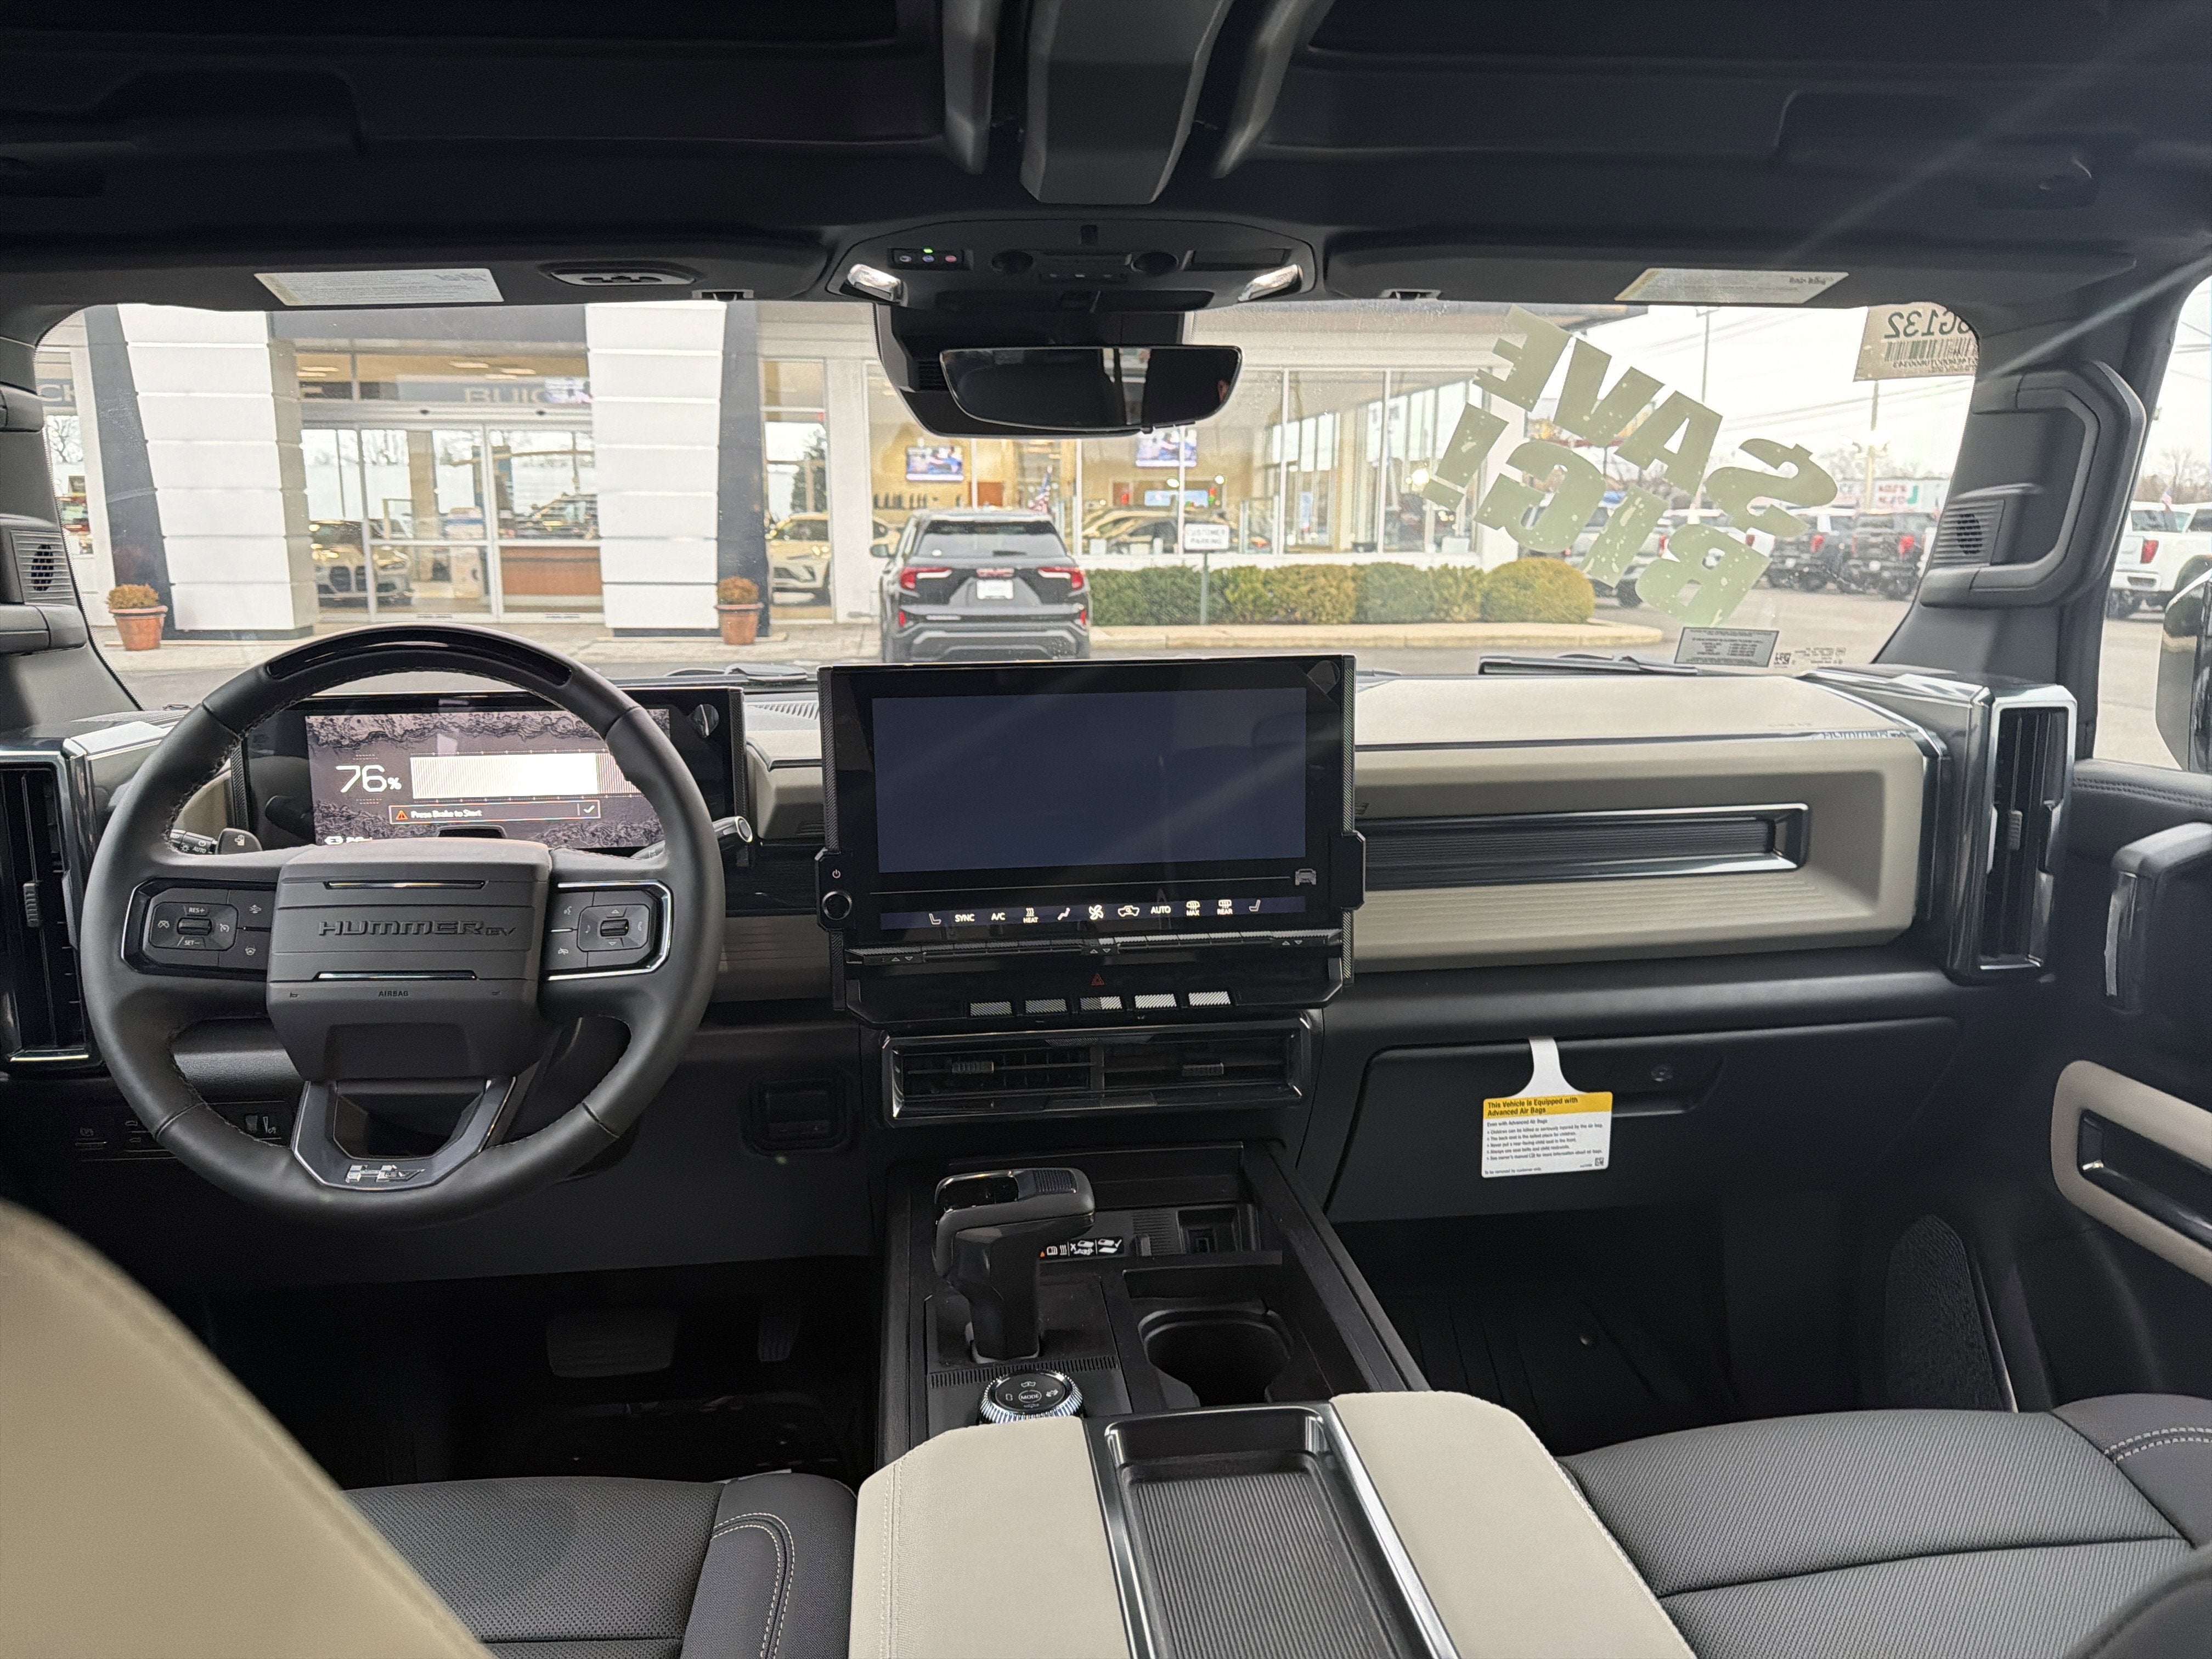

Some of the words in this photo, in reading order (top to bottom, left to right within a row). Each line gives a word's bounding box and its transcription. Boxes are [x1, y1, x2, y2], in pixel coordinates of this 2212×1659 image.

[336, 764, 402, 793] 76%
[411, 810, 432, 819] Press
[432, 810, 453, 818] Brake
[463, 809, 483, 817] Start
[1150, 905, 1171, 914] AUTO
[955, 913, 975, 923] SYNC
[991, 912, 1006, 921] A/C
[318, 921, 483, 936] HUMMER
[1534, 1097, 1562, 1107] Equipped
[1487, 1108, 1519, 1117] Advanced
[1531, 1107, 1546, 1115] Bags
